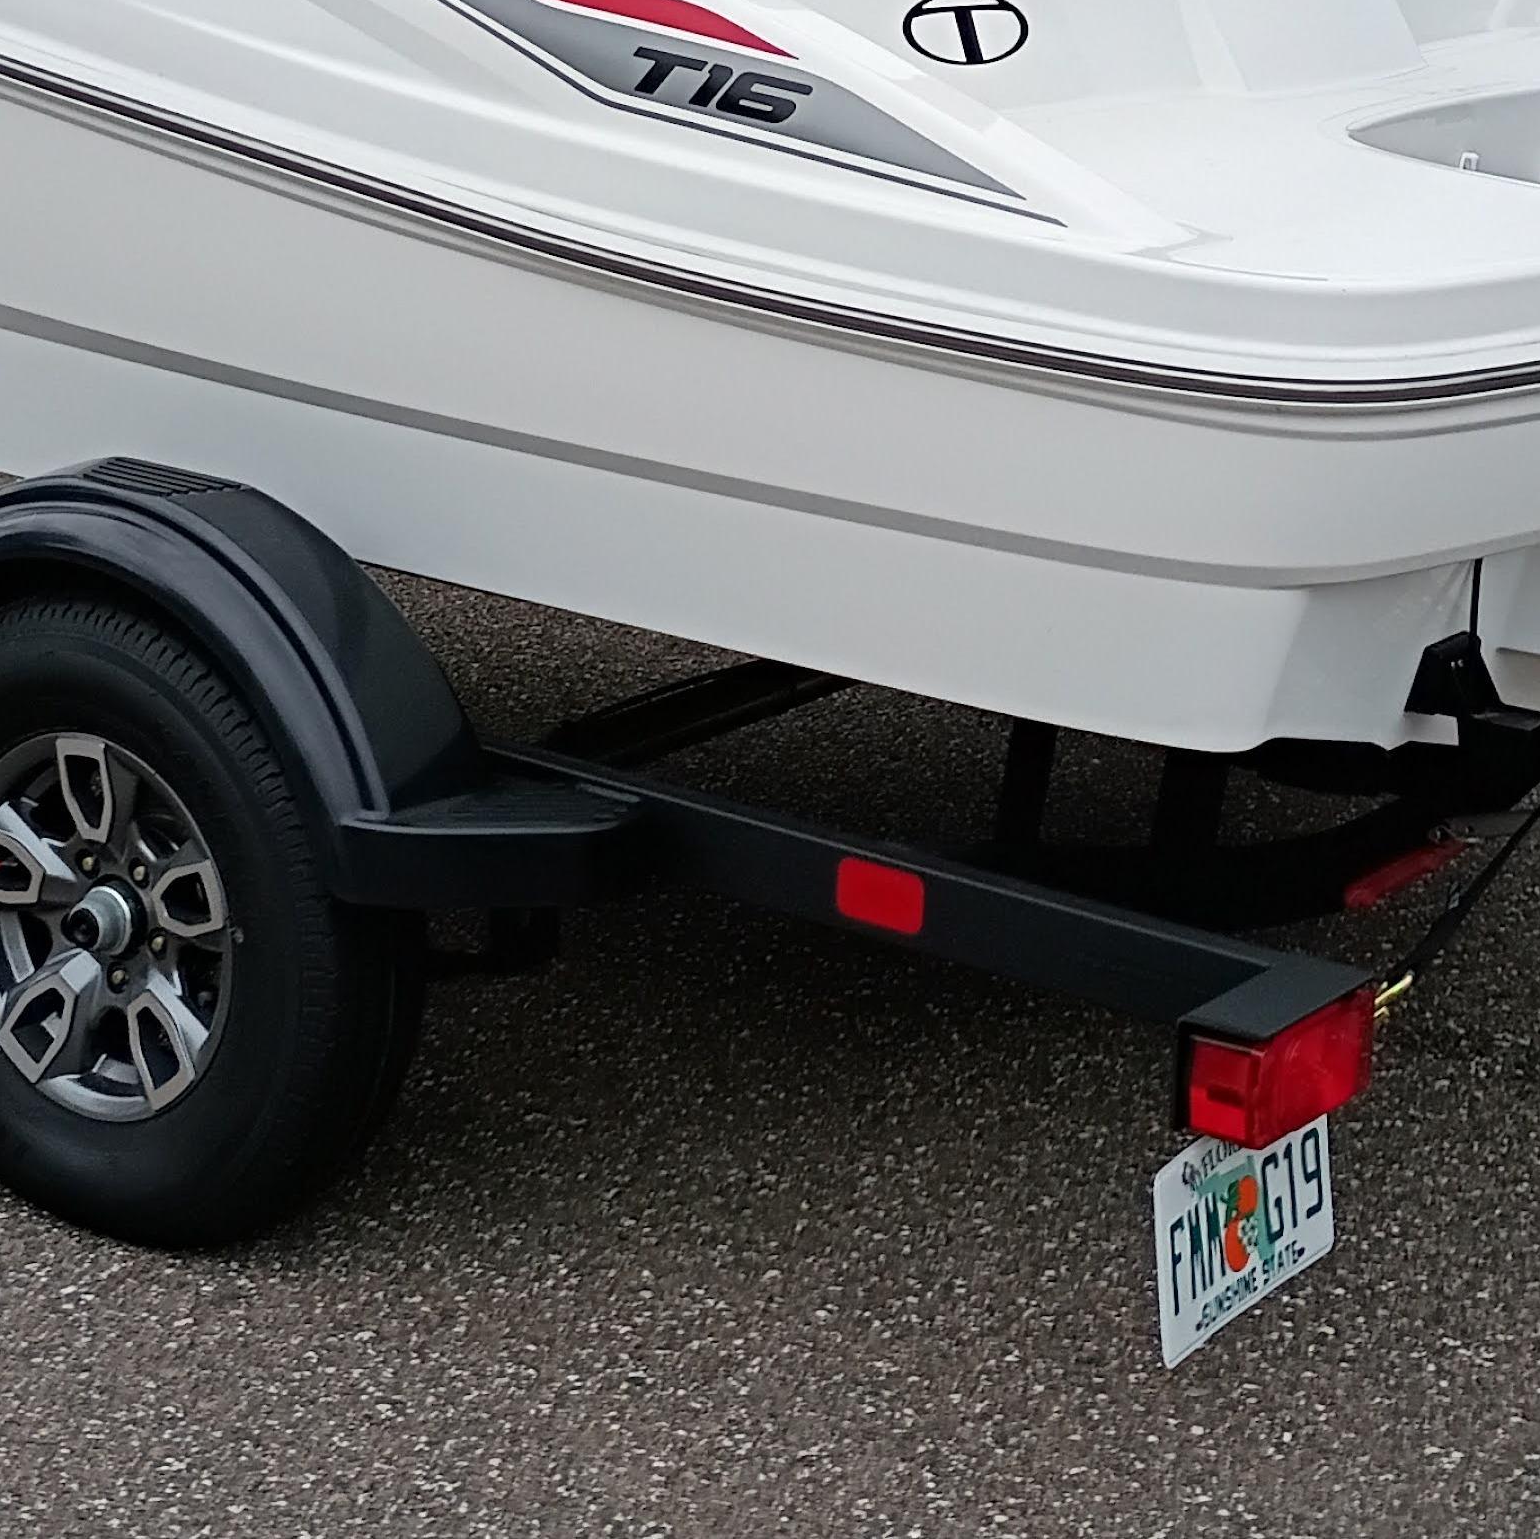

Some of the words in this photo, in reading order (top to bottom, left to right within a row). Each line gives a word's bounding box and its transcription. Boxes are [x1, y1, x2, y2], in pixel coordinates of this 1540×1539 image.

[633, 46, 814, 124] T16
[1261, 1127, 1324, 1246] G19
[1202, 1266, 1258, 1327] SUNSHINE
[1262, 1239, 1300, 1285] STATE
